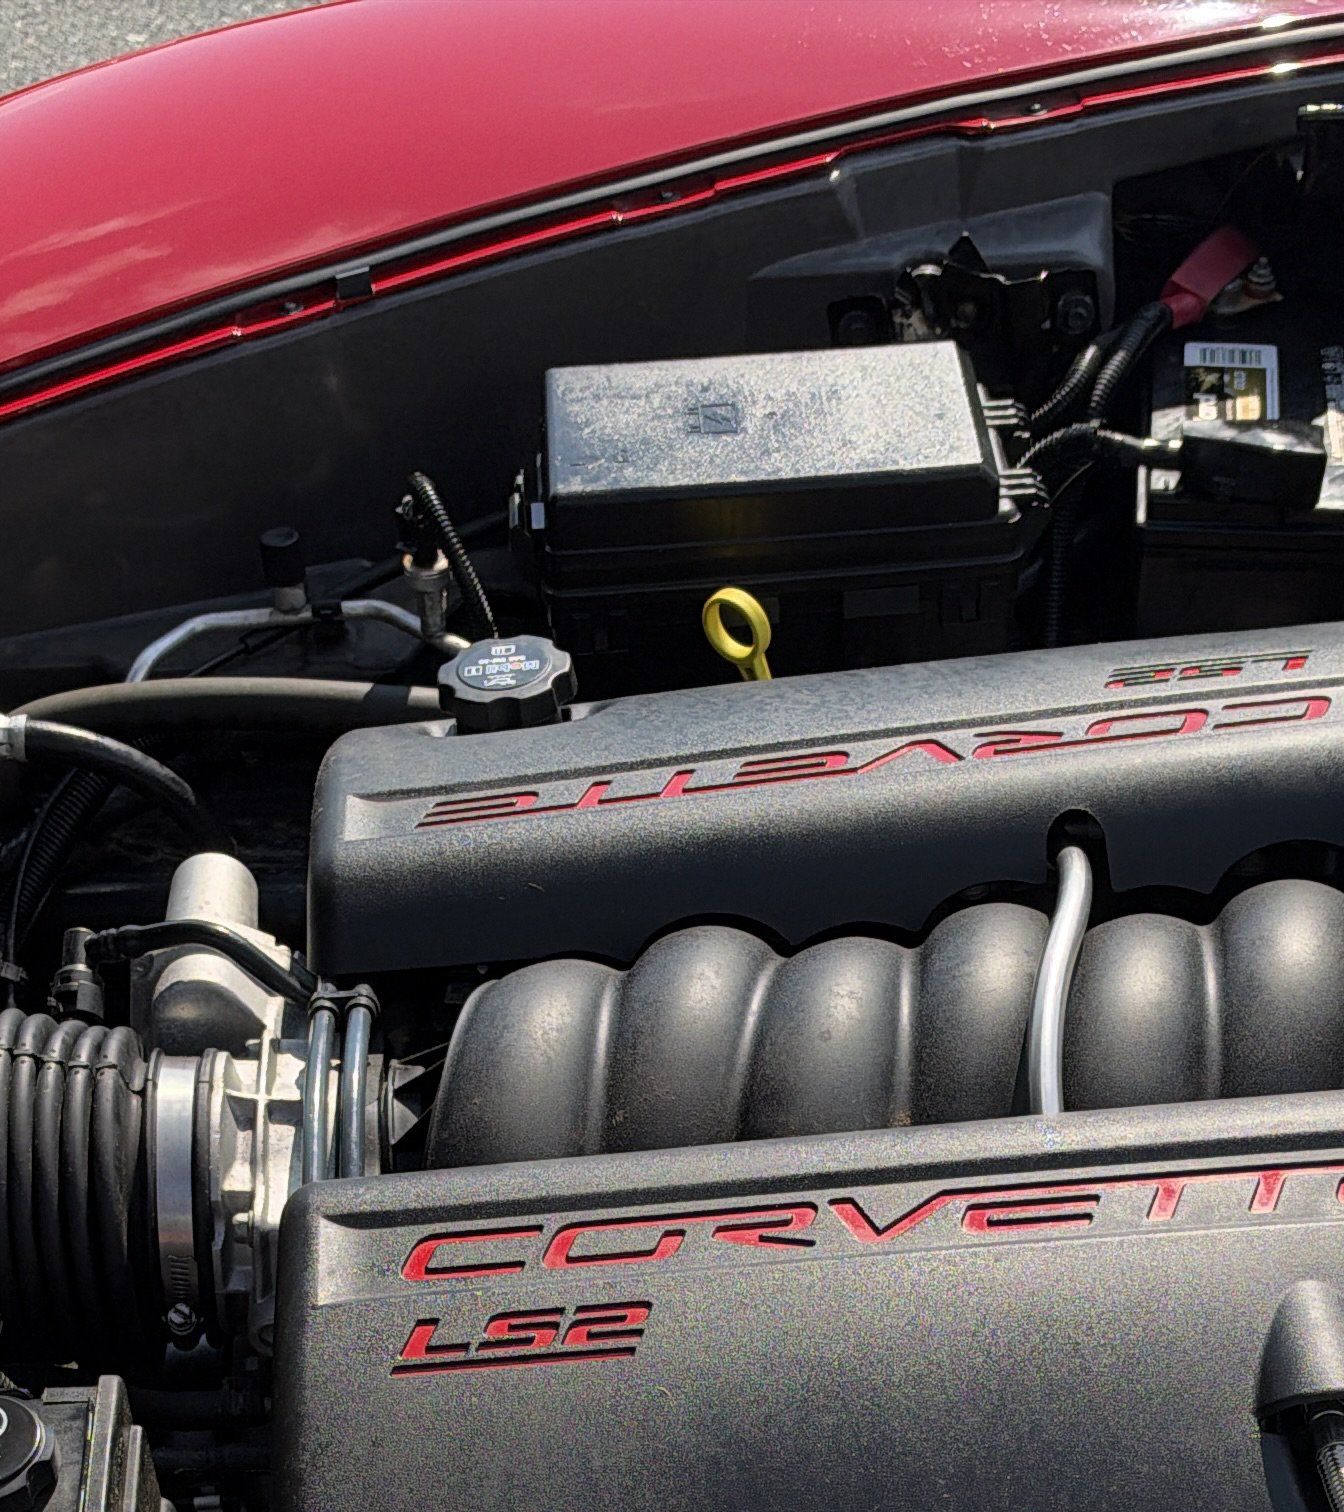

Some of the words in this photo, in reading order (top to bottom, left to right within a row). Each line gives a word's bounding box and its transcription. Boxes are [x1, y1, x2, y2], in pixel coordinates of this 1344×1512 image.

[484, 659, 540, 674] Mobil
[1104, 648, 1313, 690] LS2
[414, 695, 1333, 829] CORVETTE
[398, 1299, 654, 1361] LS2
